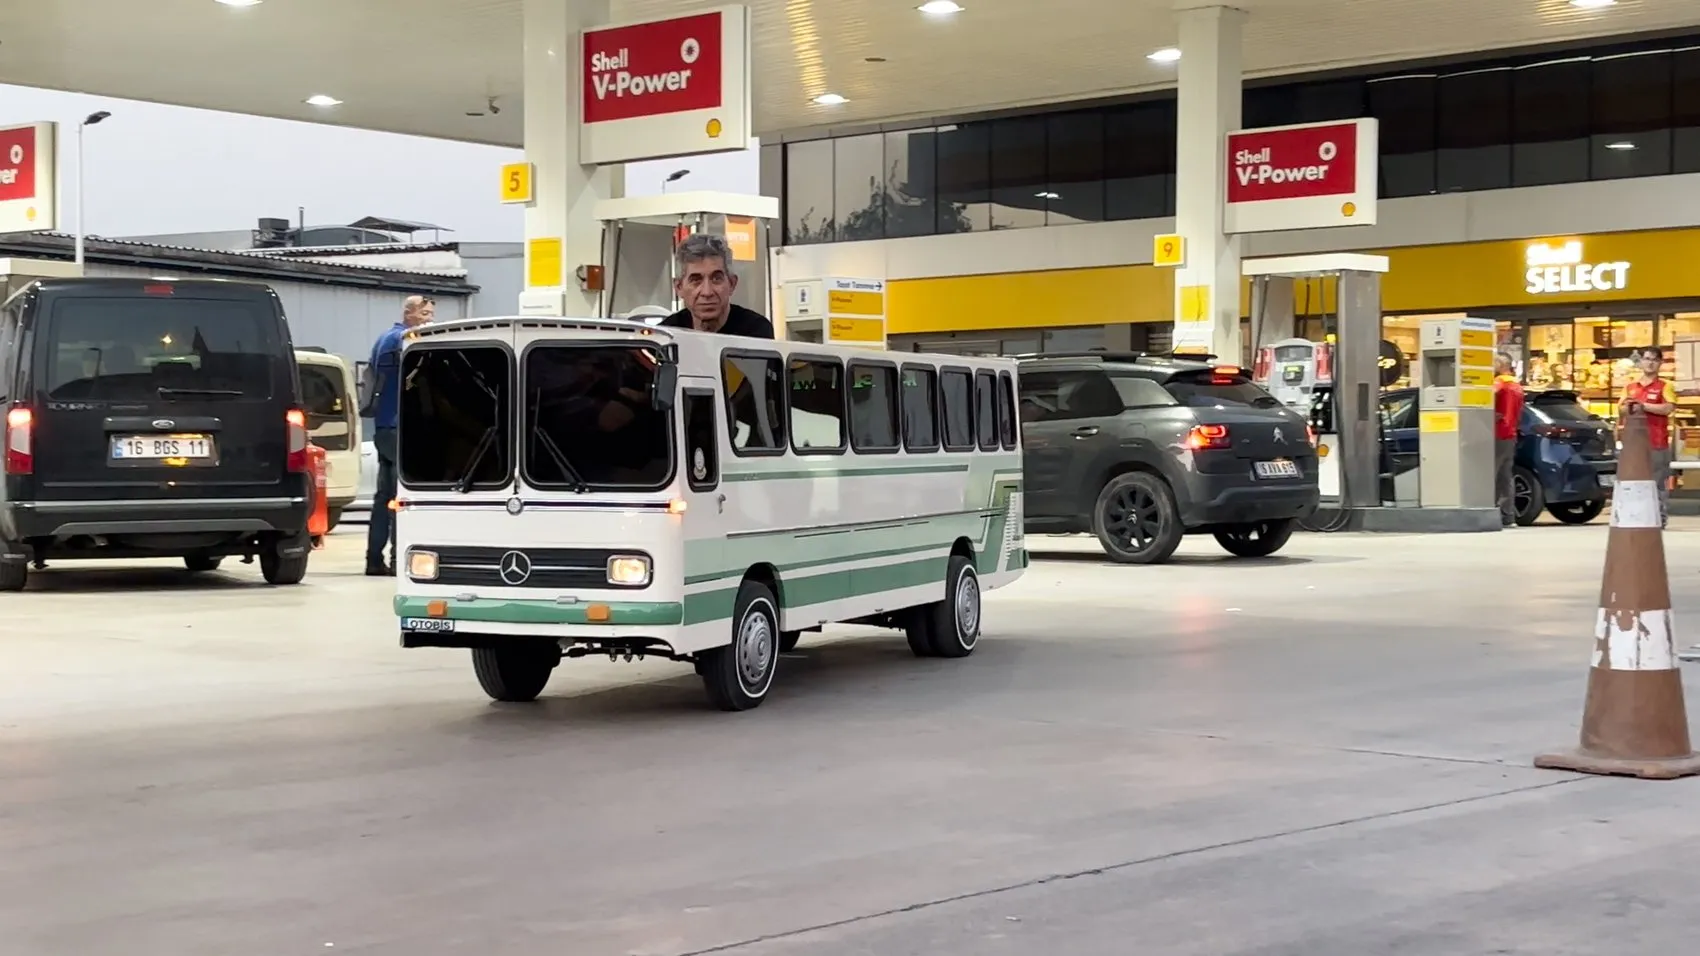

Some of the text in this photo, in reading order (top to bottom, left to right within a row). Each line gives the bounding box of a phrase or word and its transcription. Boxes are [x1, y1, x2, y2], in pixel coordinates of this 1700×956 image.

[591, 48, 628, 72] Shell
[592, 69, 692, 100] V-Power
[1235, 147, 1271, 165] Shell
[509, 171, 521, 193] 5
[1235, 164, 1329, 186] V-Power
[1163, 242, 1173, 258] 9
[1525, 261, 1632, 294] SELECT
[127, 441, 204, 455] 16 BGS 11
